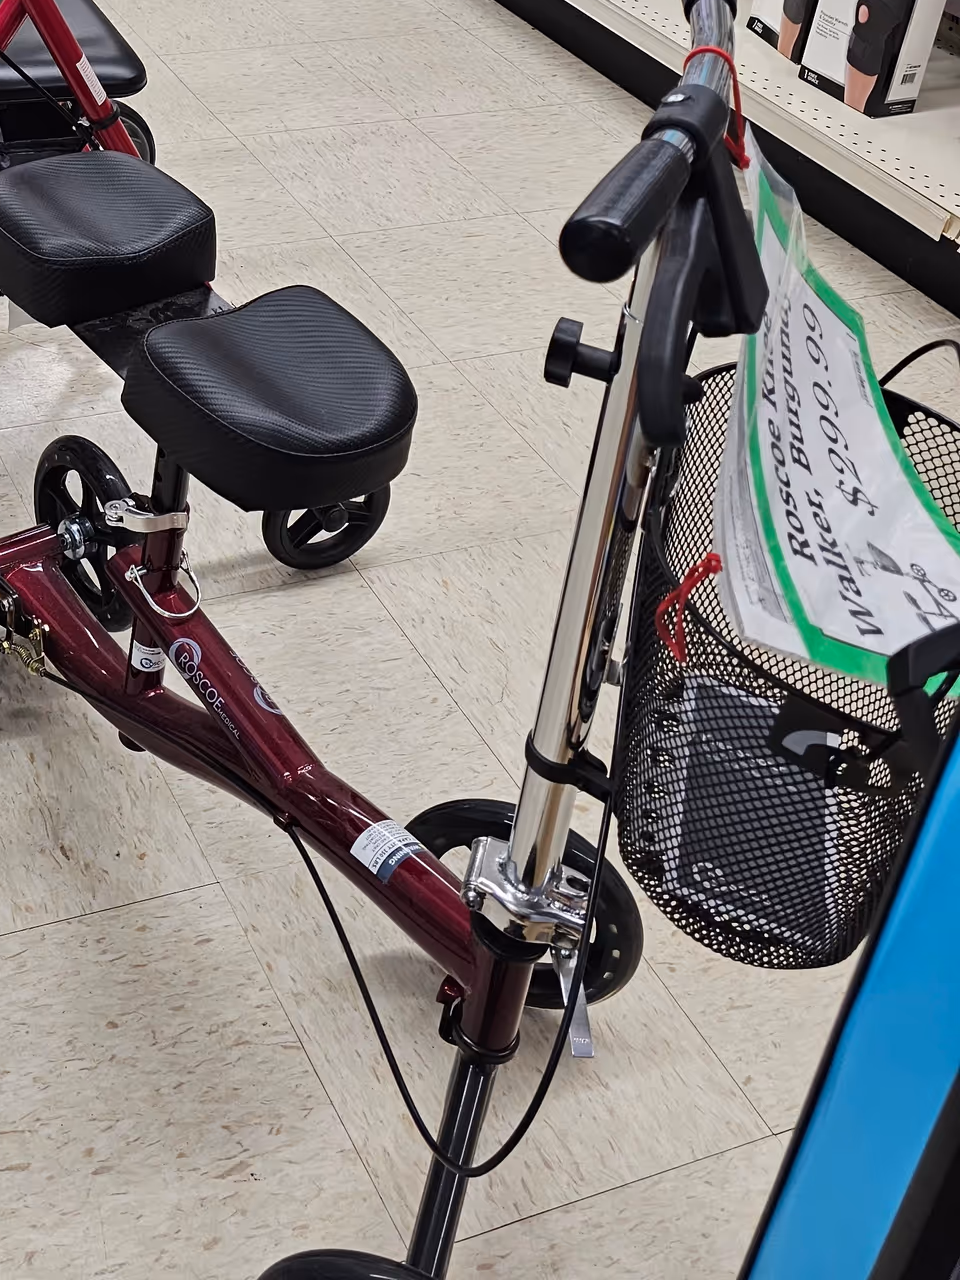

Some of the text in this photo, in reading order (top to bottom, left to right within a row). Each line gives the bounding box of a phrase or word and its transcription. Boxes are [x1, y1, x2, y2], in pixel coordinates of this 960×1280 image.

[761, 309, 818, 566] Roscoe Knee
[802, 302, 881, 518] $299.99
[804, 487, 885, 637] Walker,
[177, 651, 225, 712] ROSCOE
[216, 707, 240, 740] MEDICAL
[388, 836, 412, 851] CAPAITY
